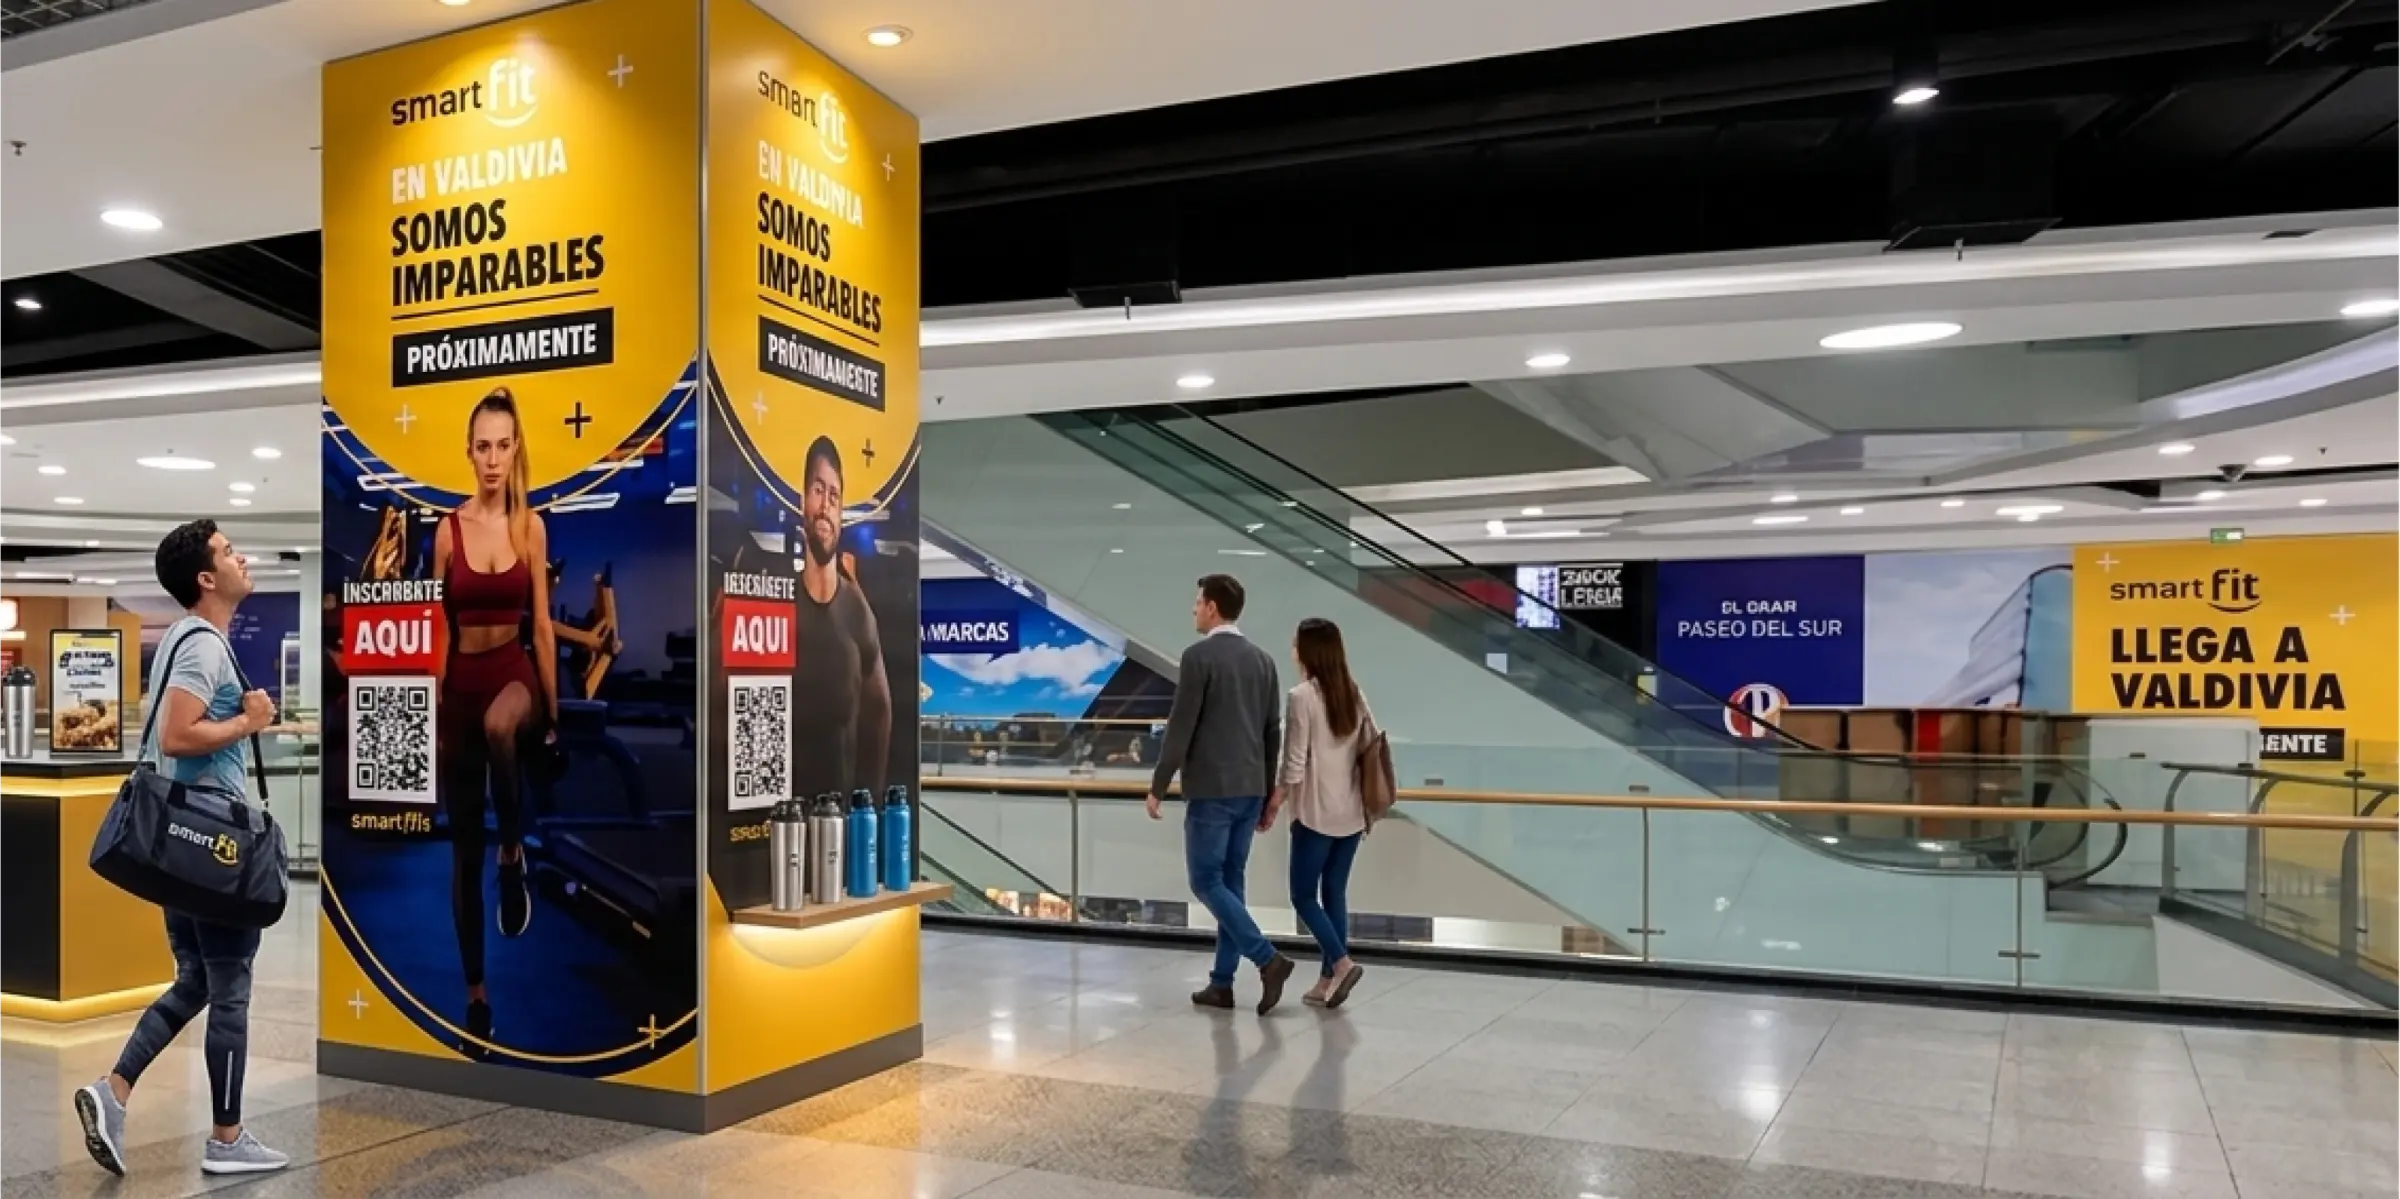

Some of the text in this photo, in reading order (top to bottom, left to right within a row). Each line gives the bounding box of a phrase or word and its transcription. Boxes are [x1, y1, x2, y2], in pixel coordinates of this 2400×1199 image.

[391, 57, 537, 126] smart fit
[392, 138, 567, 204] EN VALDIVIA
[392, 198, 506, 257] SOMOS
[758, 192, 831, 262] SOMOS
[392, 234, 605, 307] IMPARABLES
[758, 243, 881, 333] IMPARABLES
[407, 323, 597, 375] PRÓXIMAMENTE
[2110, 568, 2260, 601] smart fit
[732, 615, 789, 655] AQUI
[1677, 620, 1842, 638] PASEO DEL SUR
[2111, 627, 2309, 664] LLEGA A
[2110, 673, 2346, 711] VALDIVIA
[2260, 734, 2328, 754] ENTE
